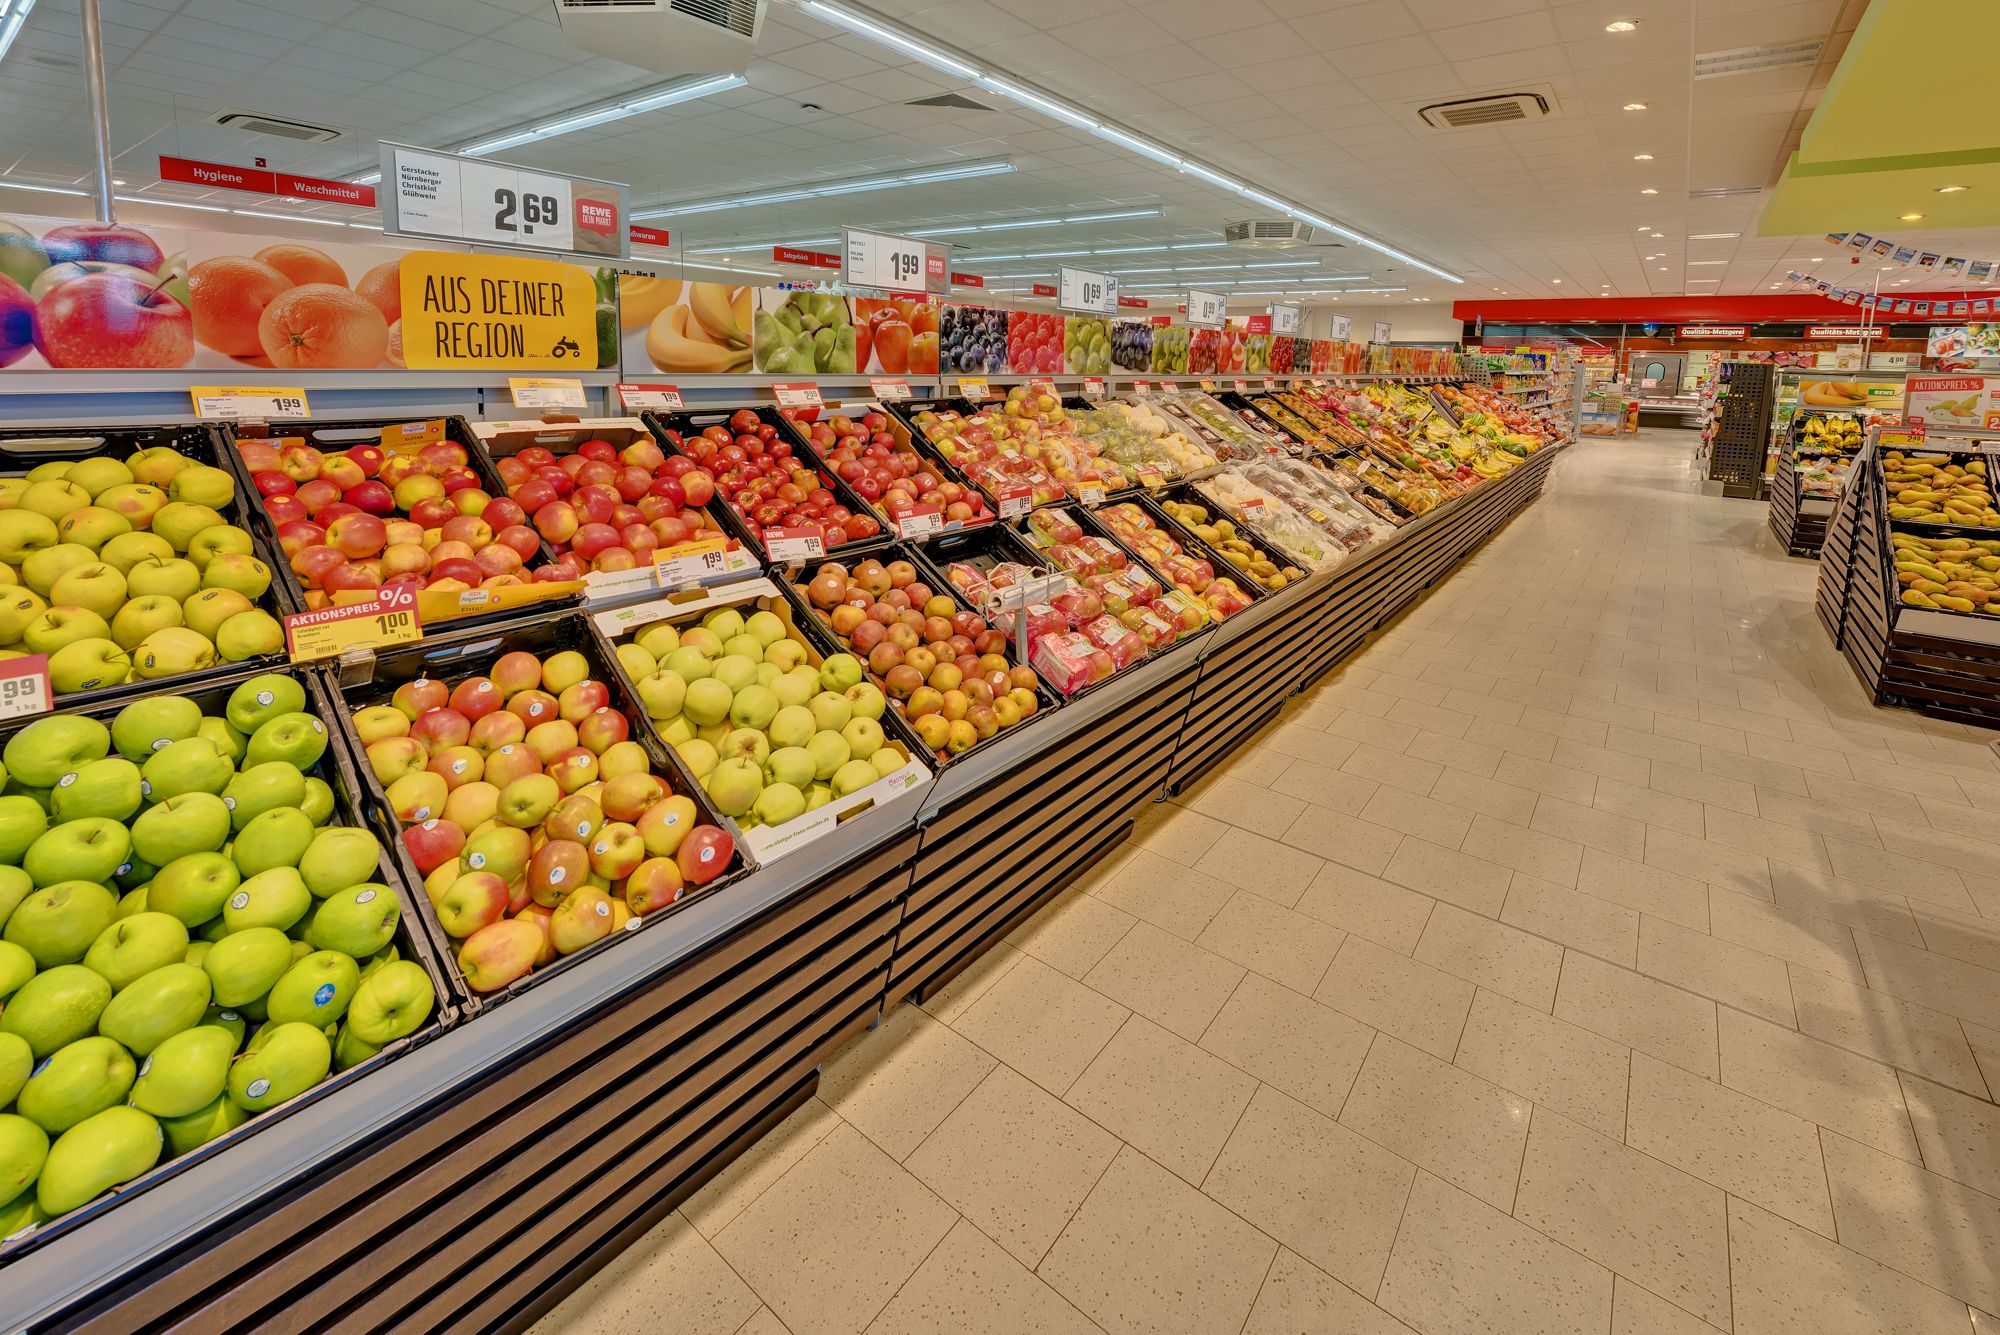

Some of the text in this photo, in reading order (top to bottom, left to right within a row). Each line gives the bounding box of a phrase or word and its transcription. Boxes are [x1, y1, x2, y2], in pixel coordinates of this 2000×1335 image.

[193, 167, 243, 184] Hygiene
[401, 165, 440, 177] Gerstacker
[401, 173, 442, 186] Nürnberger
[293, 181, 360, 200] Waschmittel
[402, 189, 436, 200] Glühwein
[494, 188, 558, 235] 2.69
[582, 204, 612, 218] REWE
[582, 214, 612, 227] DEIN MARKT
[783, 251, 809, 261] Salzgebäck
[890, 252, 919, 282] 1.99
[928, 259, 943, 268] REWE
[1106, 279, 1116, 297] ja!
[424, 274, 565, 317] AUS DEINER
[435, 321, 525, 359] REGION
[1914, 380, 1980, 391] AKTIONSPREIS %
[661, 392, 678, 403] 1.99
[272, 398, 301, 411] 1.99
[1912, 427, 1925, 435] %
[898, 510, 913, 518] REWE
[928, 514, 940, 527] 1.99
[766, 531, 785, 539] REWE
[804, 538, 820, 552] 1.99
[702, 551, 722, 569] 1.99
[290, 586, 413, 628] AKTIONSPREIS %
[375, 611, 409, 636] 1.00
[24, 703, 37, 711] kg
